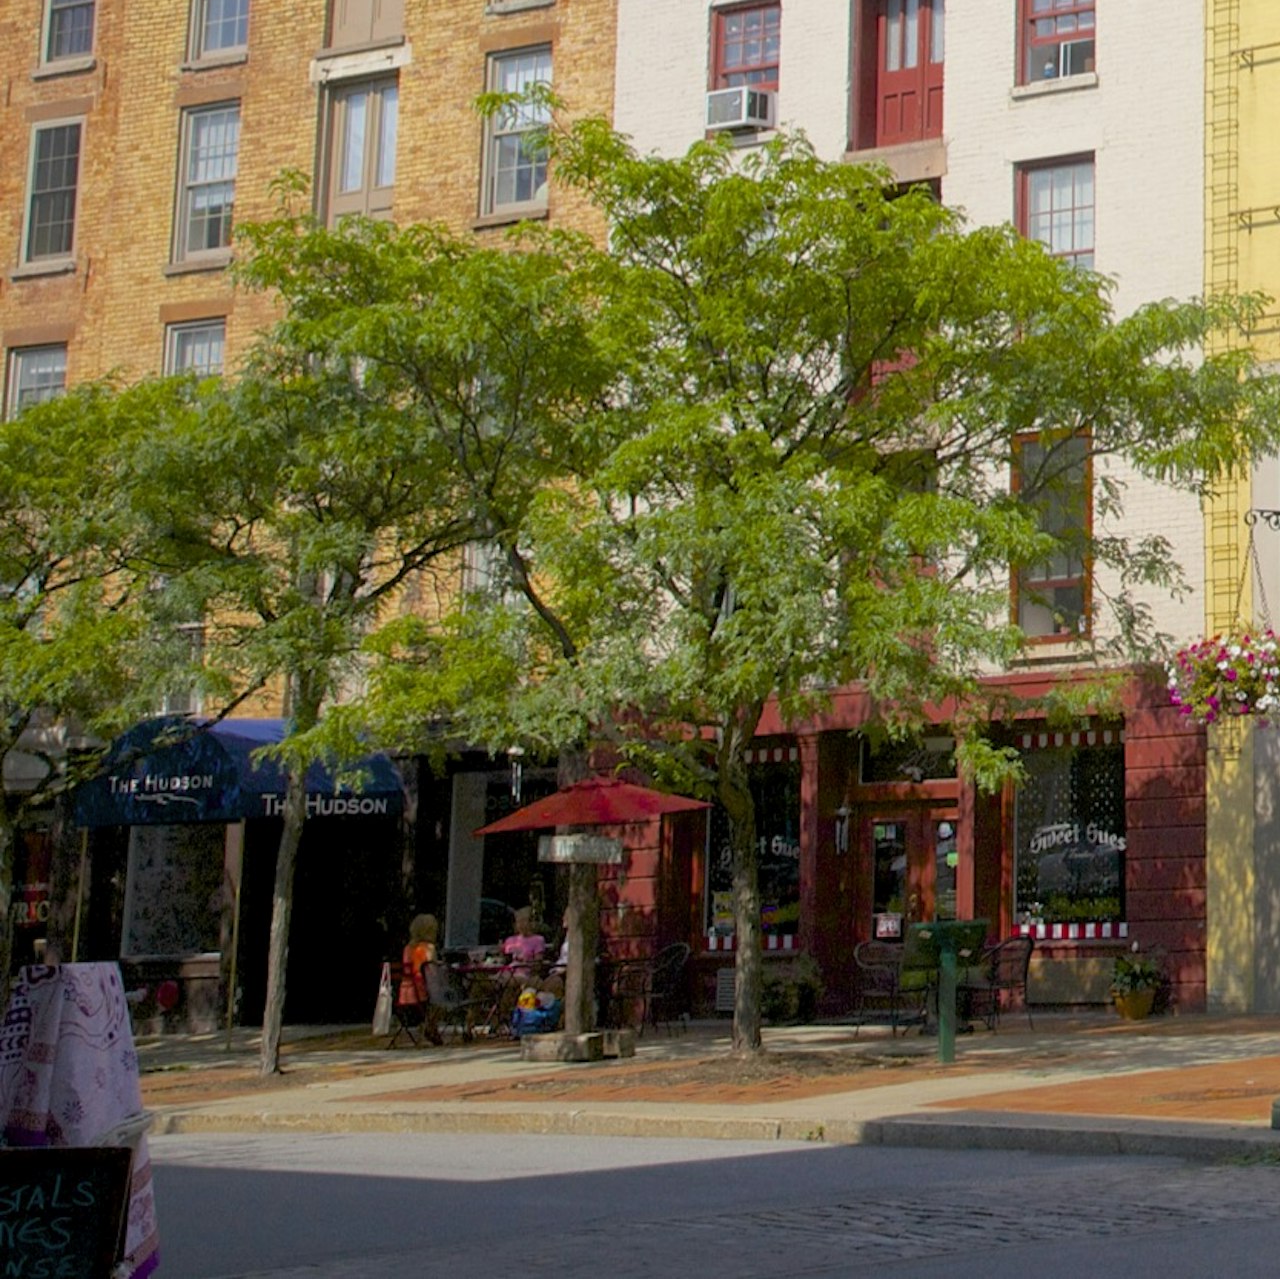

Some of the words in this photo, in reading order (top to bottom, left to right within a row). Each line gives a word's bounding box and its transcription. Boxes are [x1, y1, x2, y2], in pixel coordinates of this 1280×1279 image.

[109, 775, 138, 794] THE
[145, 774, 214, 792] HUDSON
[262, 793, 287, 817] TH
[305, 793, 388, 816] HUDSON
[772, 835, 800, 859] Sue
[1030, 823, 1081, 854] Sweet
[1087, 822, 1127, 851] Sues
